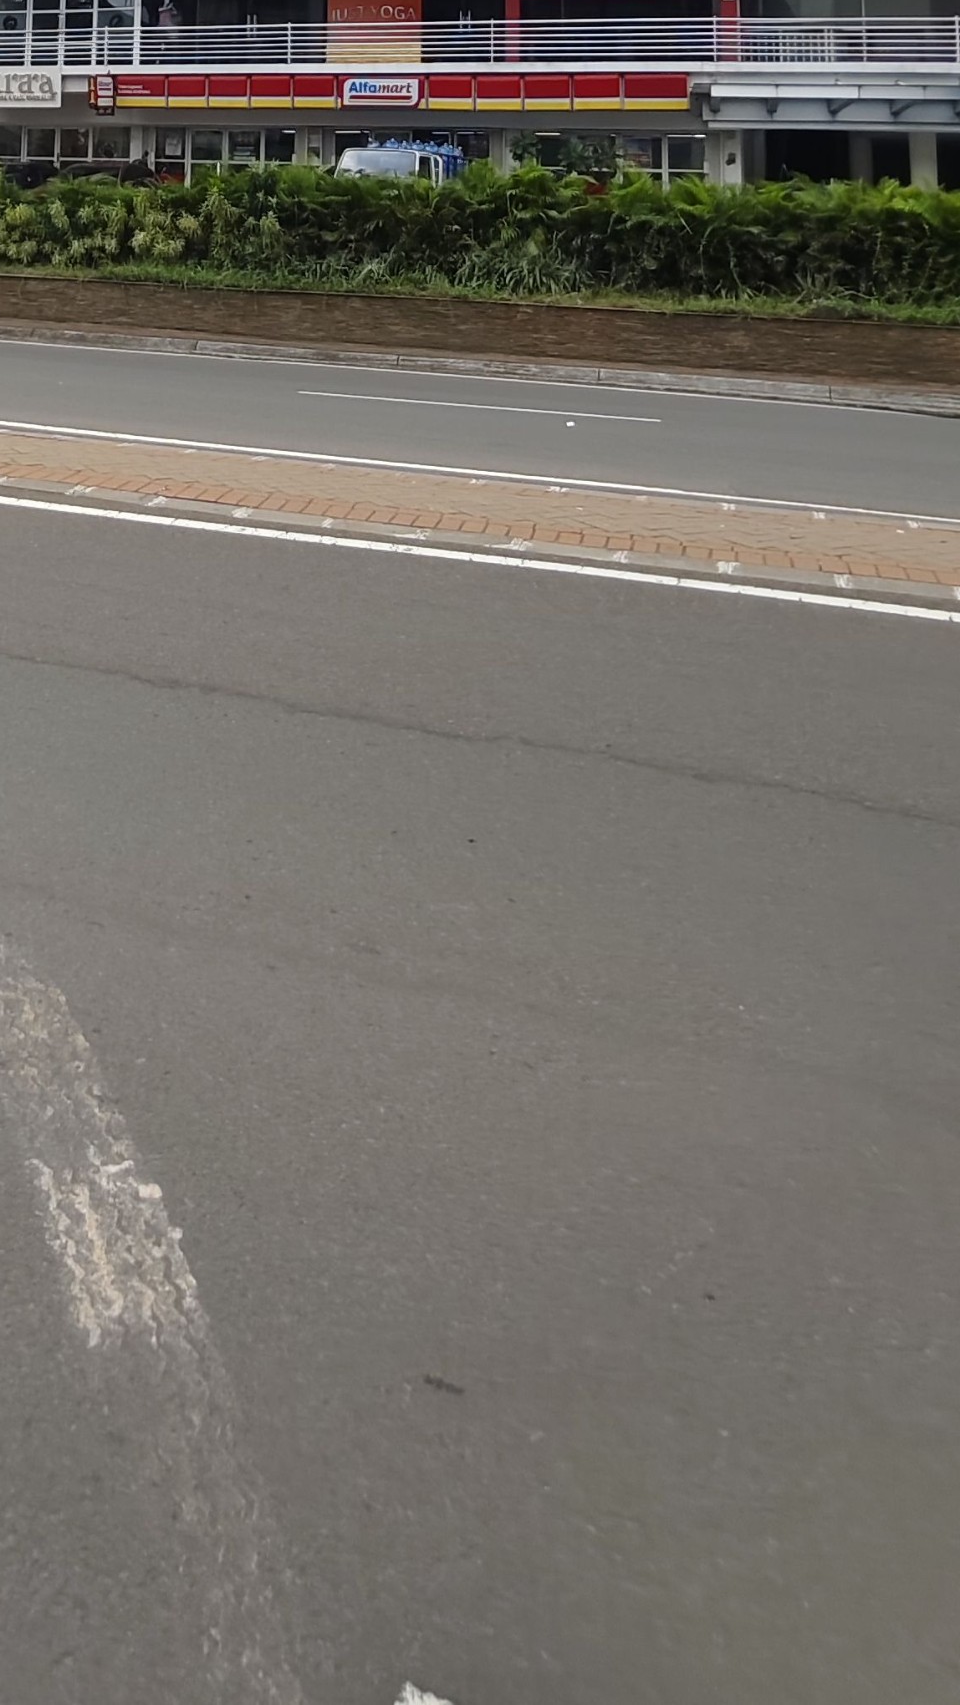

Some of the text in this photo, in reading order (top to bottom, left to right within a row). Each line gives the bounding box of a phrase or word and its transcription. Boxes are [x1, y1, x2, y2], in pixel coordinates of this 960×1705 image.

[332, 5, 416, 21] JUT YOGA
[348, 81, 413, 94] Alfamart
